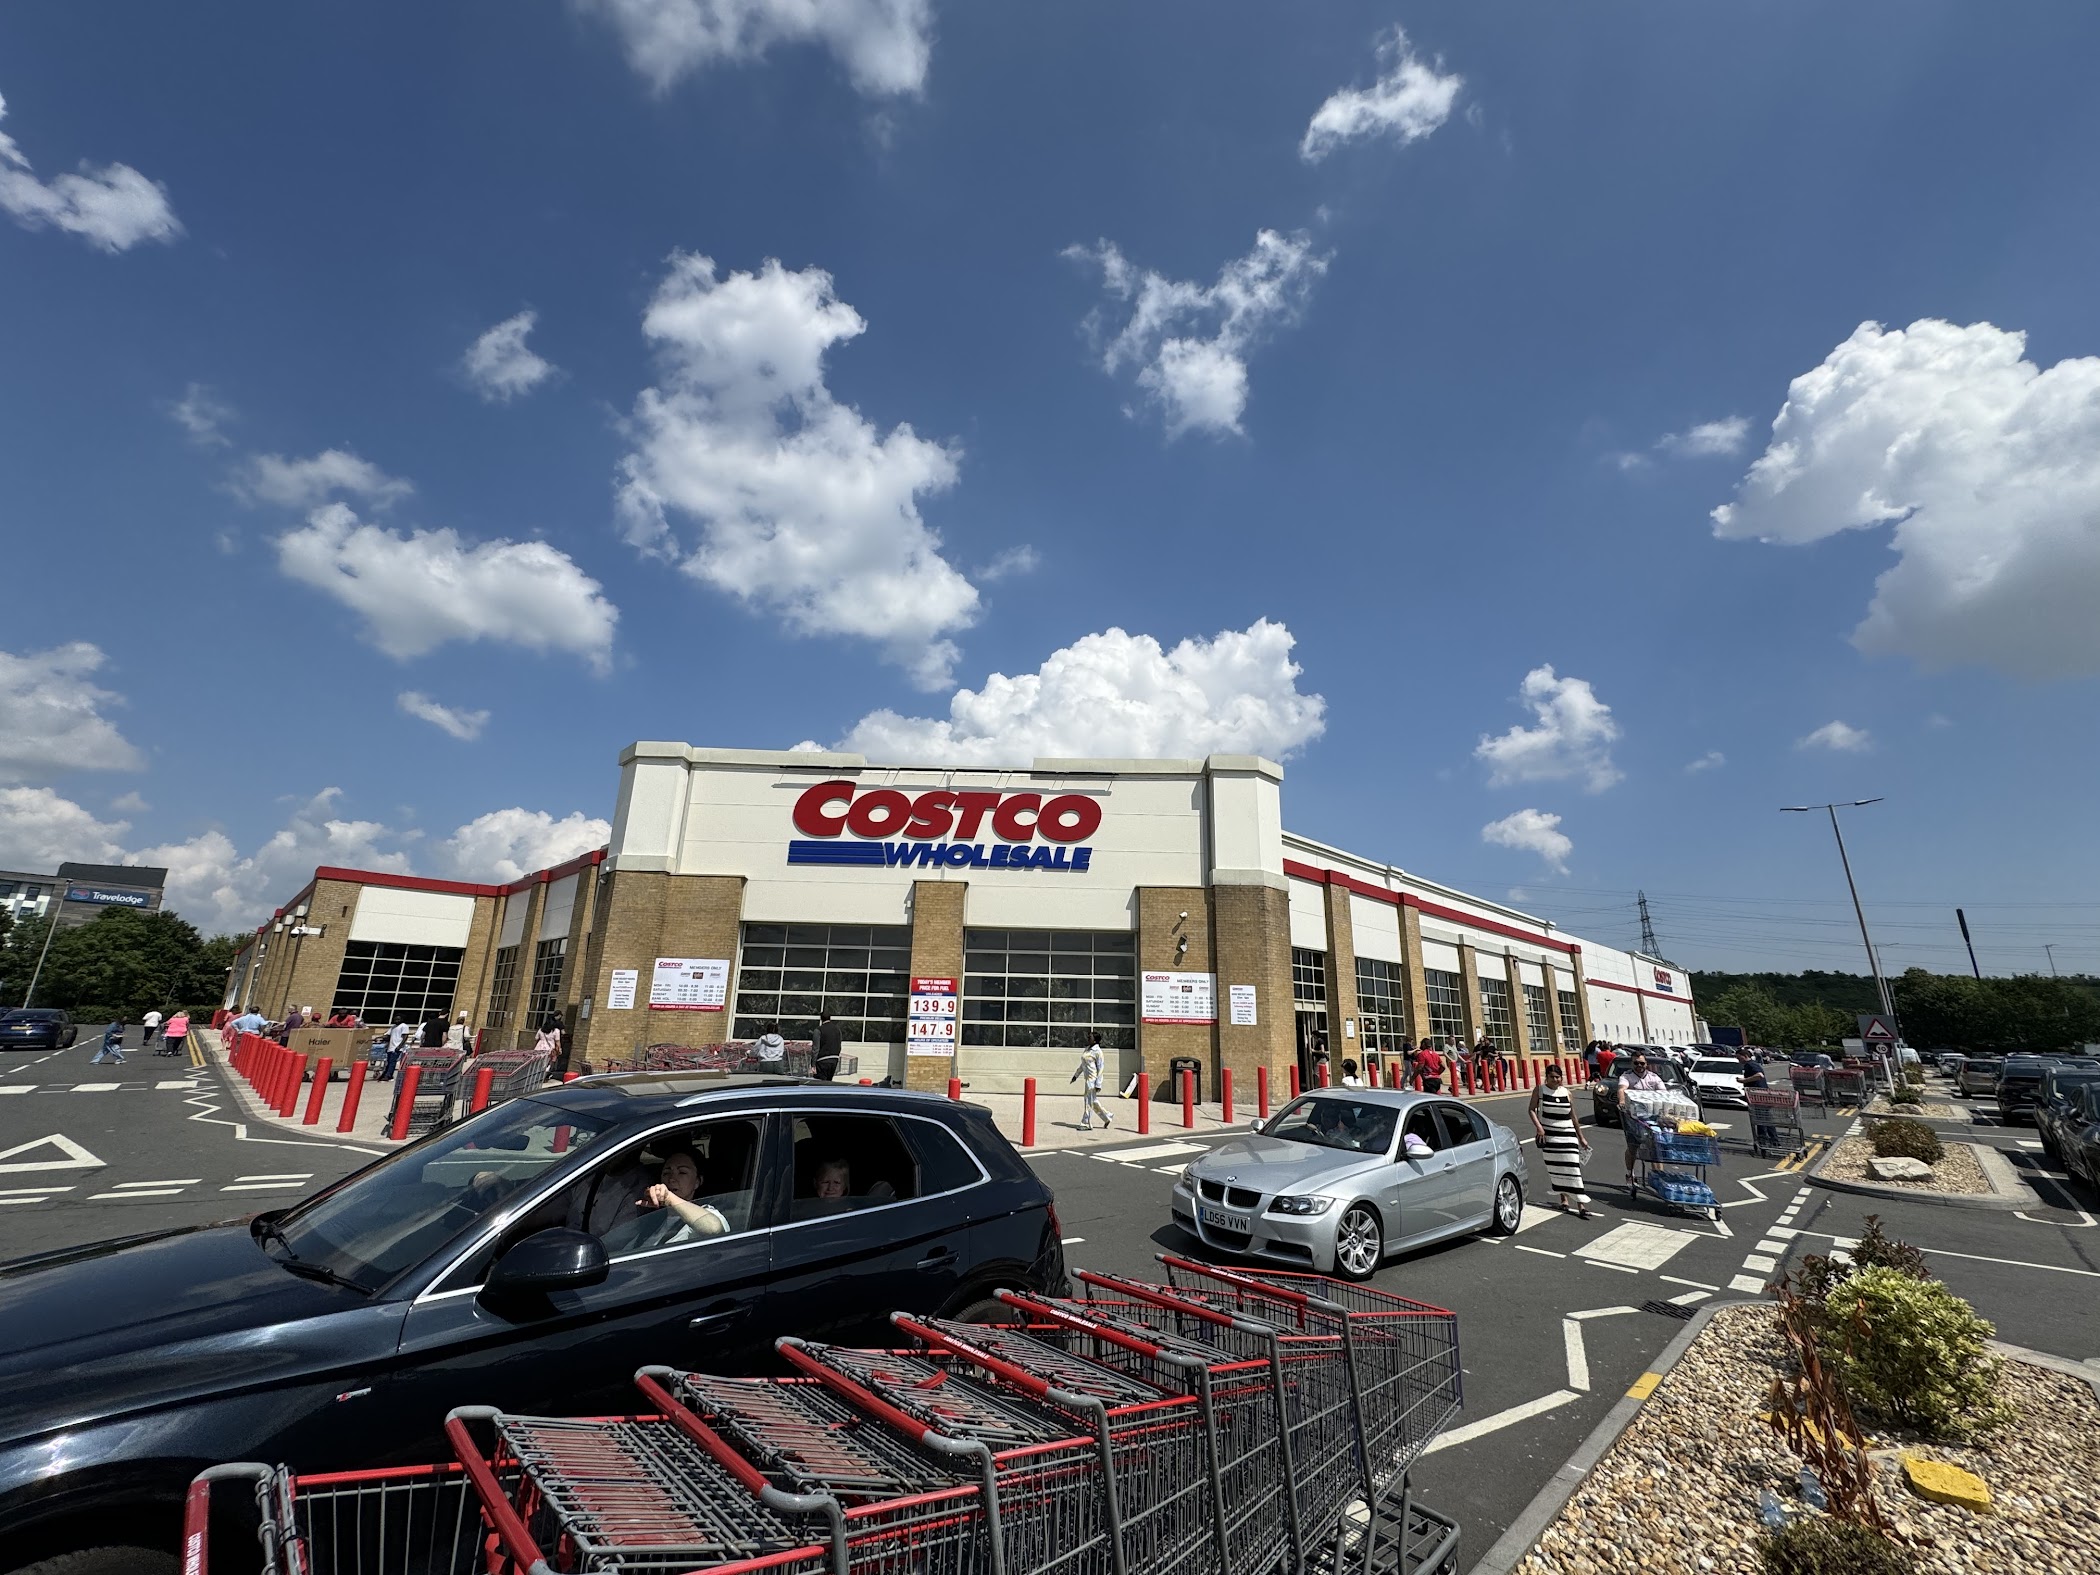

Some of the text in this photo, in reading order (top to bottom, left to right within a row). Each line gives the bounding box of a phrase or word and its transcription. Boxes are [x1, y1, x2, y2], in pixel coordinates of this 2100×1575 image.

[792, 780, 1102, 843] COSTCO
[884, 842, 1093, 872] WHOLESALE
[92, 892, 143, 904] Travelodge
[914, 1000, 954, 1012] 139.9
[912, 1023, 953, 1036] 147.9
[1228, 1216, 1247, 1231] VVN
